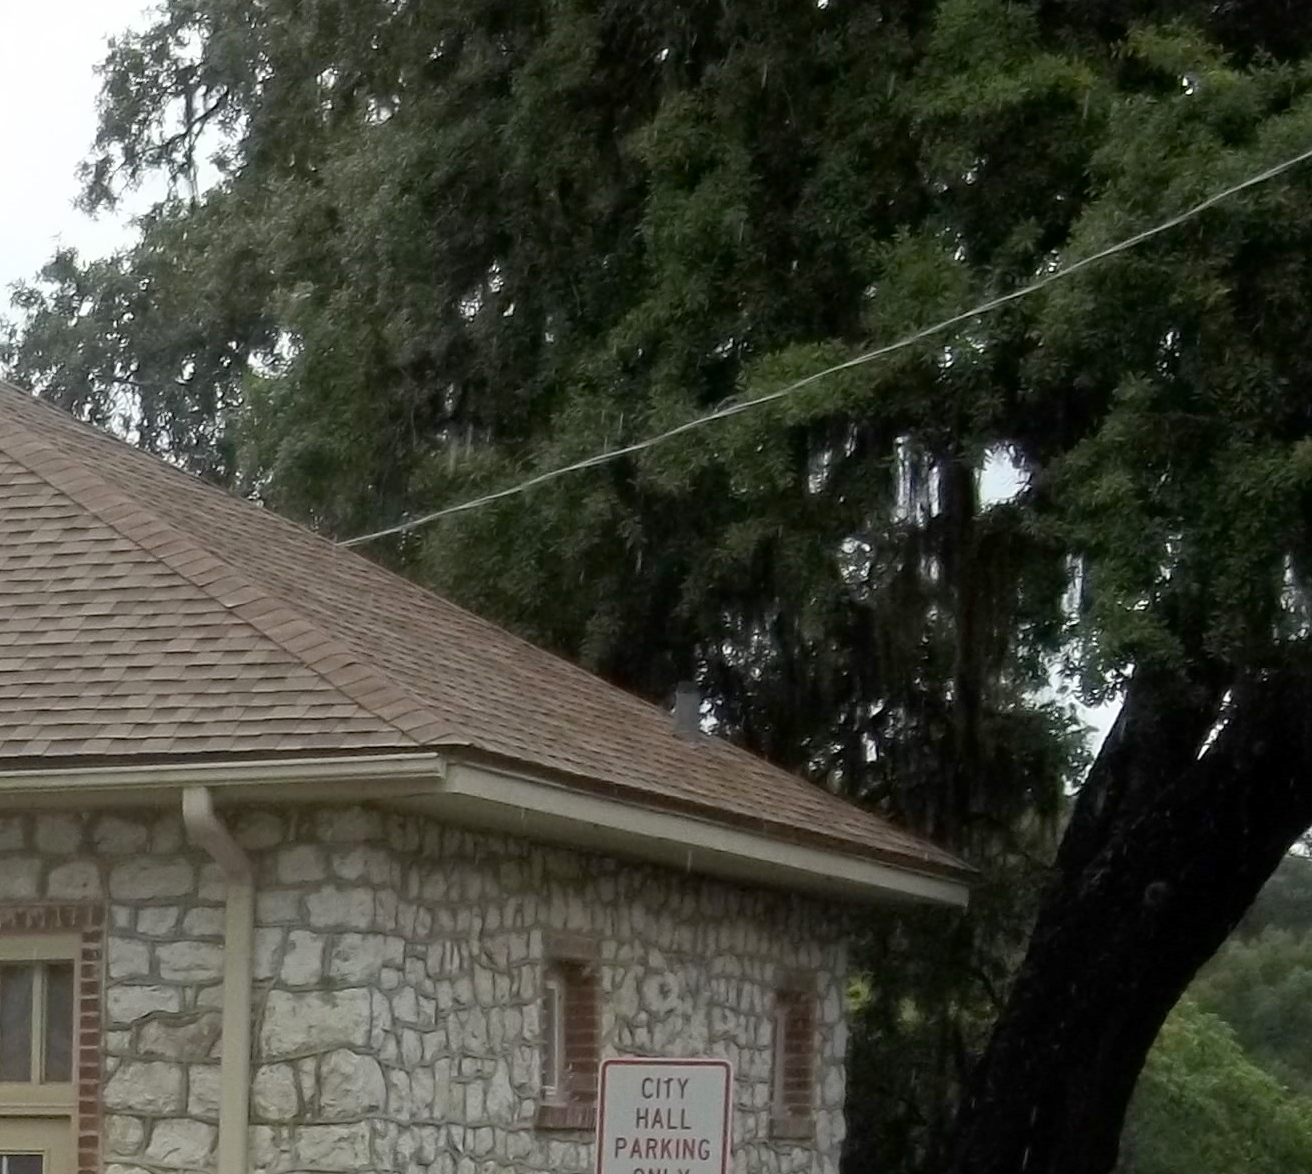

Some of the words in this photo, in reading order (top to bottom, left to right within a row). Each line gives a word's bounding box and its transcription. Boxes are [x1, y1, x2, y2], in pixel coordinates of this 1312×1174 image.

[641, 1077, 689, 1099] CITY
[635, 1107, 692, 1130] HALL
[614, 1137, 711, 1161] PARKING
